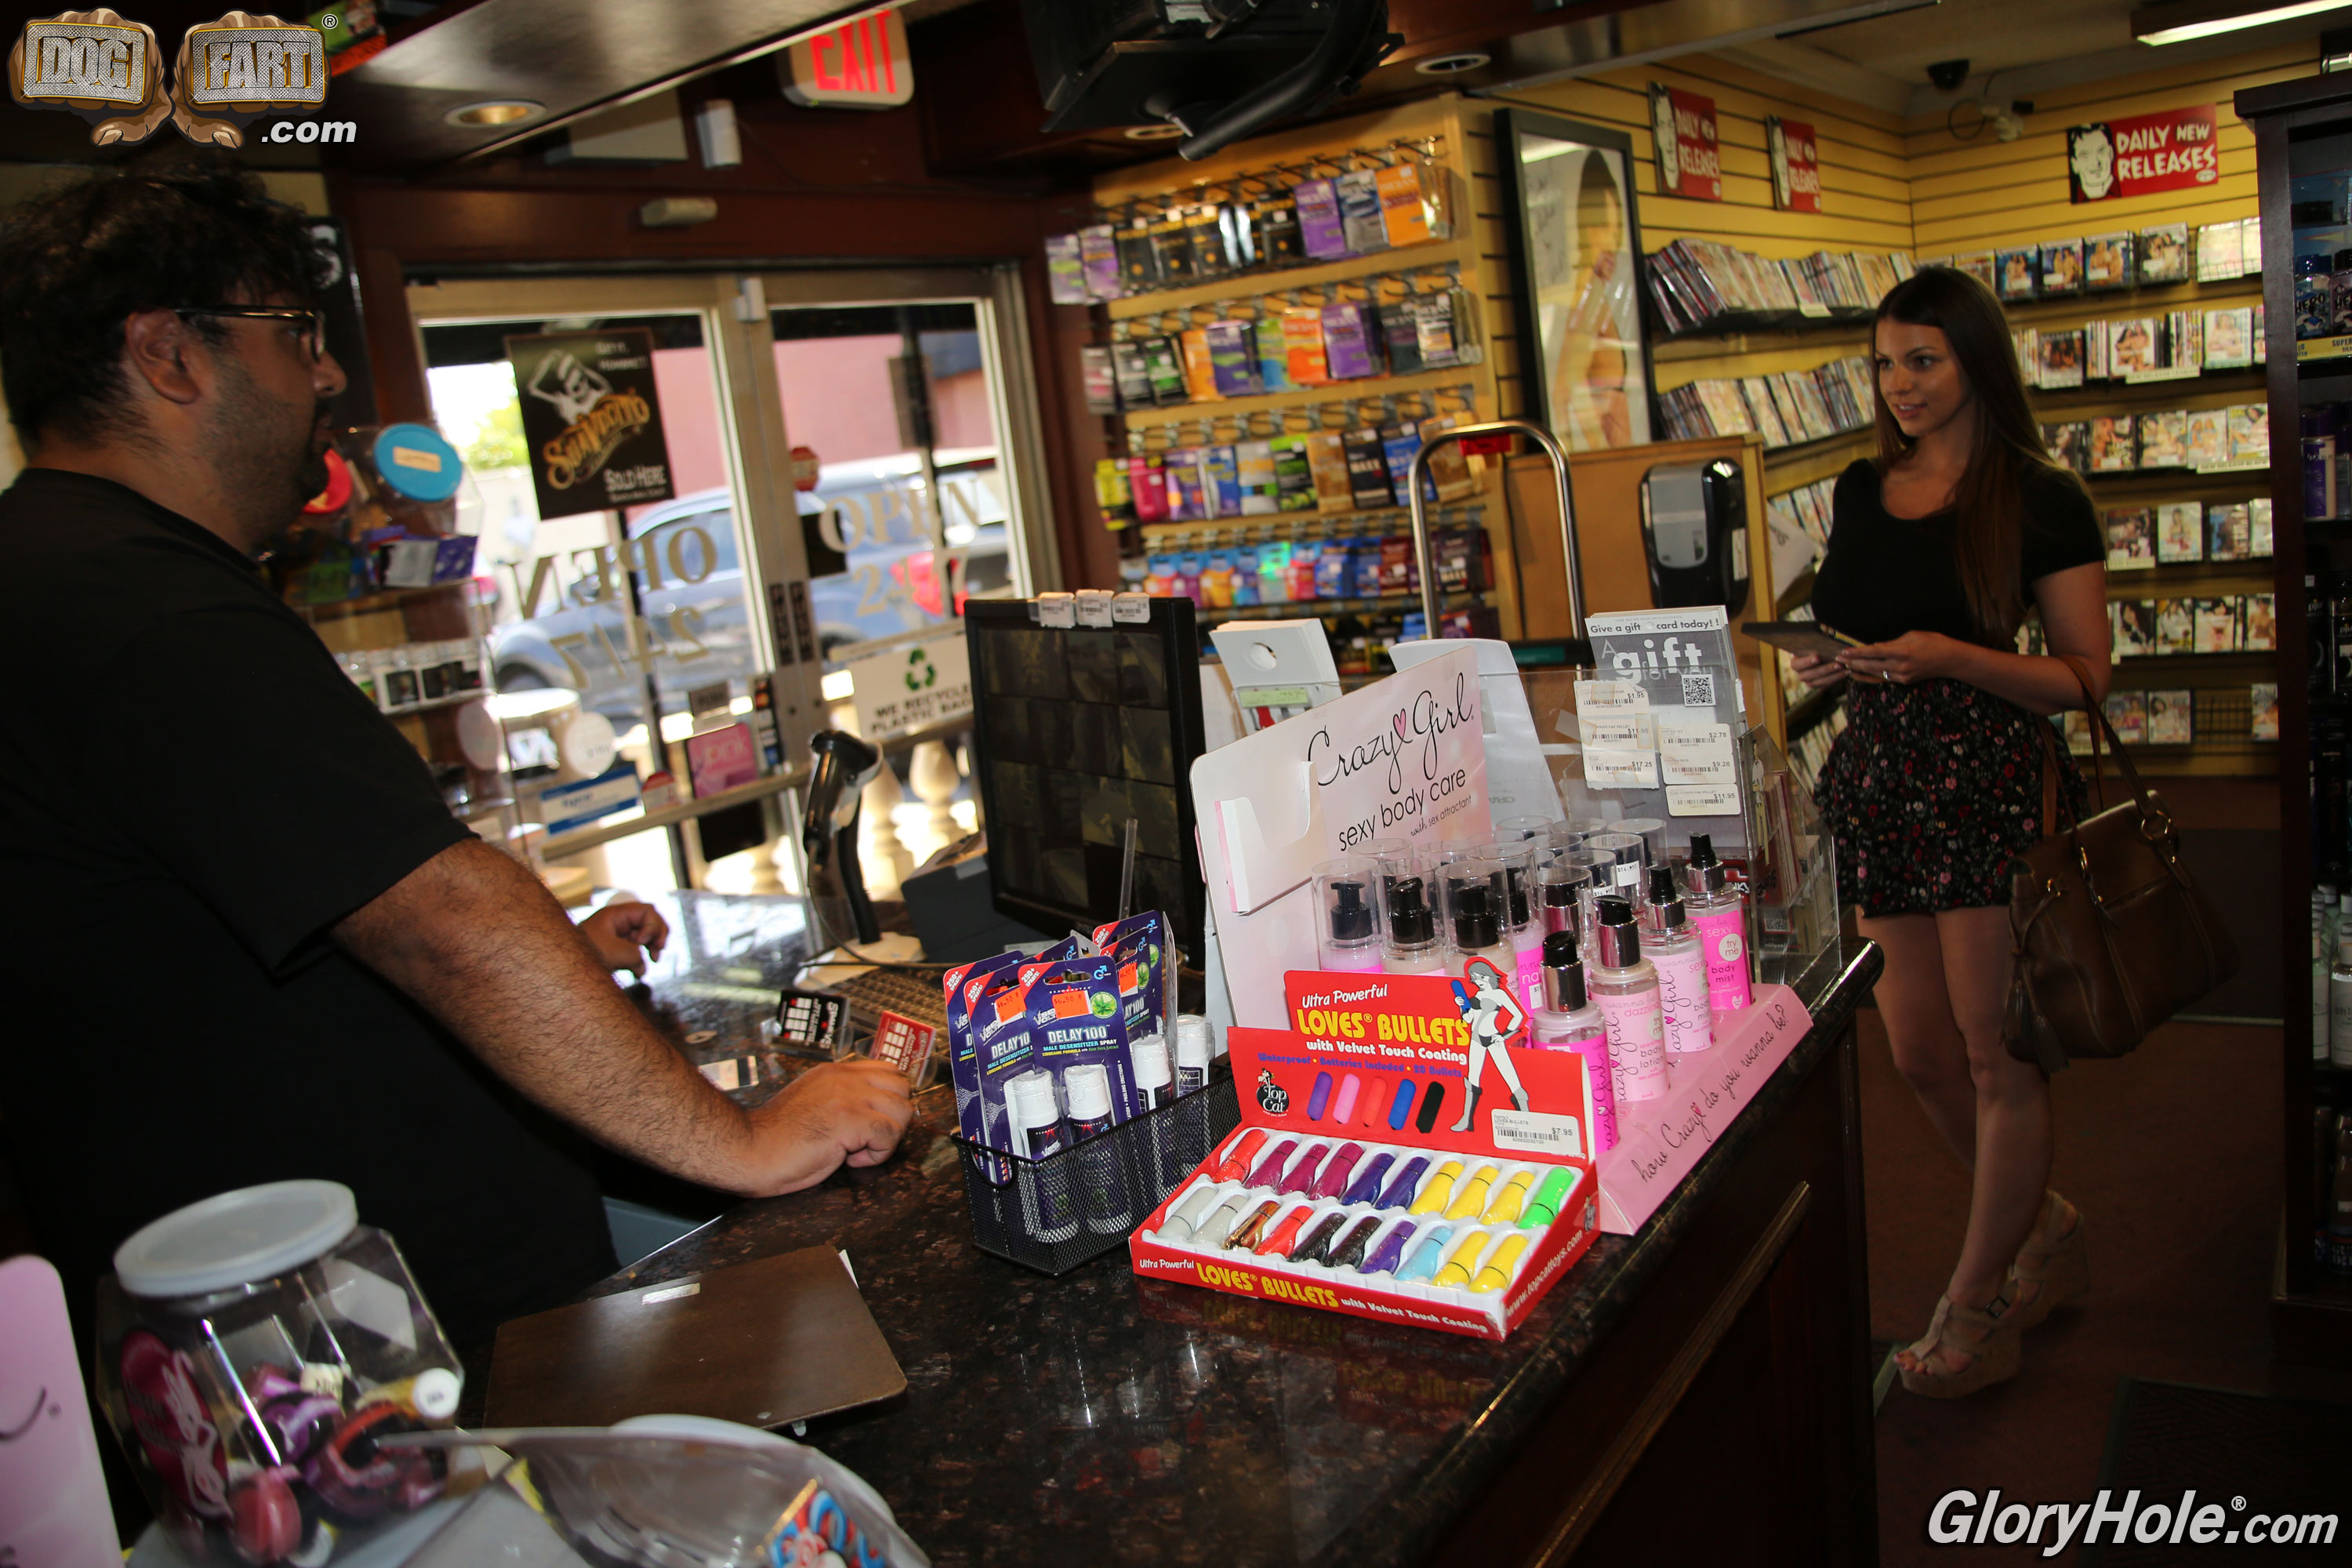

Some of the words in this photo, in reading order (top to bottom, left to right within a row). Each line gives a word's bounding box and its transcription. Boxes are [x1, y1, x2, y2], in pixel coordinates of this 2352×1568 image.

[809, 9, 896, 93] EXIT
[2116, 124, 2170, 154] DAILY
[2176, 122, 2210, 142] NEW
[2117, 143, 2216, 182] RELEASES
[2296, 292, 2325, 314] HERO
[2335, 294, 2352, 309] HE
[1625, 622, 1641, 633] gift
[1656, 621, 1678, 630] card
[1601, 639, 1619, 659] A
[1613, 637, 1702, 684] gift
[876, 702, 898, 717] WE
[904, 684, 971, 710] RECYCLE
[1308, 715, 1412, 794] Crazy
[1413, 672, 1474, 780] Girl
[1338, 815, 1376, 851] sexy
[1381, 787, 1425, 829] body
[1429, 769, 1466, 802] care
[1410, 818, 1428, 837] with
[1428, 815, 1439, 828] sex
[1440, 794, 1472, 820] attractant
[1706, 926, 1733, 938] sexy
[1725, 948, 1739, 956] me
[1726, 940, 1737, 949] try
[947, 970, 960, 988] 250+
[1021, 967, 1036, 983] 250+
[1025, 971, 1040, 987] SPRAYS!
[1711, 964, 1736, 974] body
[1715, 975, 1734, 983] mist
[949, 974, 964, 991] SPRAYS!
[967, 982, 980, 1000] 250+
[971, 984, 984, 1004] SPRAYS!
[1054, 996, 1075, 1004] $6.50
[1301, 992, 1330, 1008] Ultra
[1333, 984, 1388, 1005] Powerful
[1377, 1014, 1470, 1046] BULLETS
[991, 1033, 1030, 1058] DELAY10
[1059, 1040, 1099, 1050] DESENSITIZER
[1306, 1040, 1334, 1051] with
[1336, 1041, 1376, 1054] Velvet
[1379, 1044, 1414, 1058] Touch
[1417, 1047, 1468, 1065] Coating
[987, 1061, 999, 1069] MALE
[1000, 1046, 1030, 1064] DESENSITIZER
[1258, 1051, 1311, 1065] Waterproof
[1320, 1058, 1363, 1069] Batteries
[1365, 1059, 1404, 1072] Included
[1428, 1066, 1463, 1078] Bullets
[1263, 1085, 1287, 1103] Top
[1631, 1151, 1668, 1183] how
[1661, 1107, 1711, 1149] Crazy
[1699, 1088, 1719, 1109] do
[1719, 1068, 1740, 1100] you
[1740, 1029, 1775, 1068] wanna
[1766, 1003, 1790, 1032] be?
[1262, 1098, 1285, 1112] Cat
[1552, 1127, 1573, 1136] $7.95
[1139, 1258, 1158, 1269] Ultra
[1159, 1258, 1195, 1270] Powerful
[1506, 1229, 1583, 1317] www.topcattoys.com
[1261, 1275, 1340, 1308] BULLETS
[1341, 1298, 1367, 1311] with
[1369, 1301, 1404, 1318] Velvet
[1406, 1308, 1439, 1323] Touch
[1441, 1315, 1488, 1334] Coating
